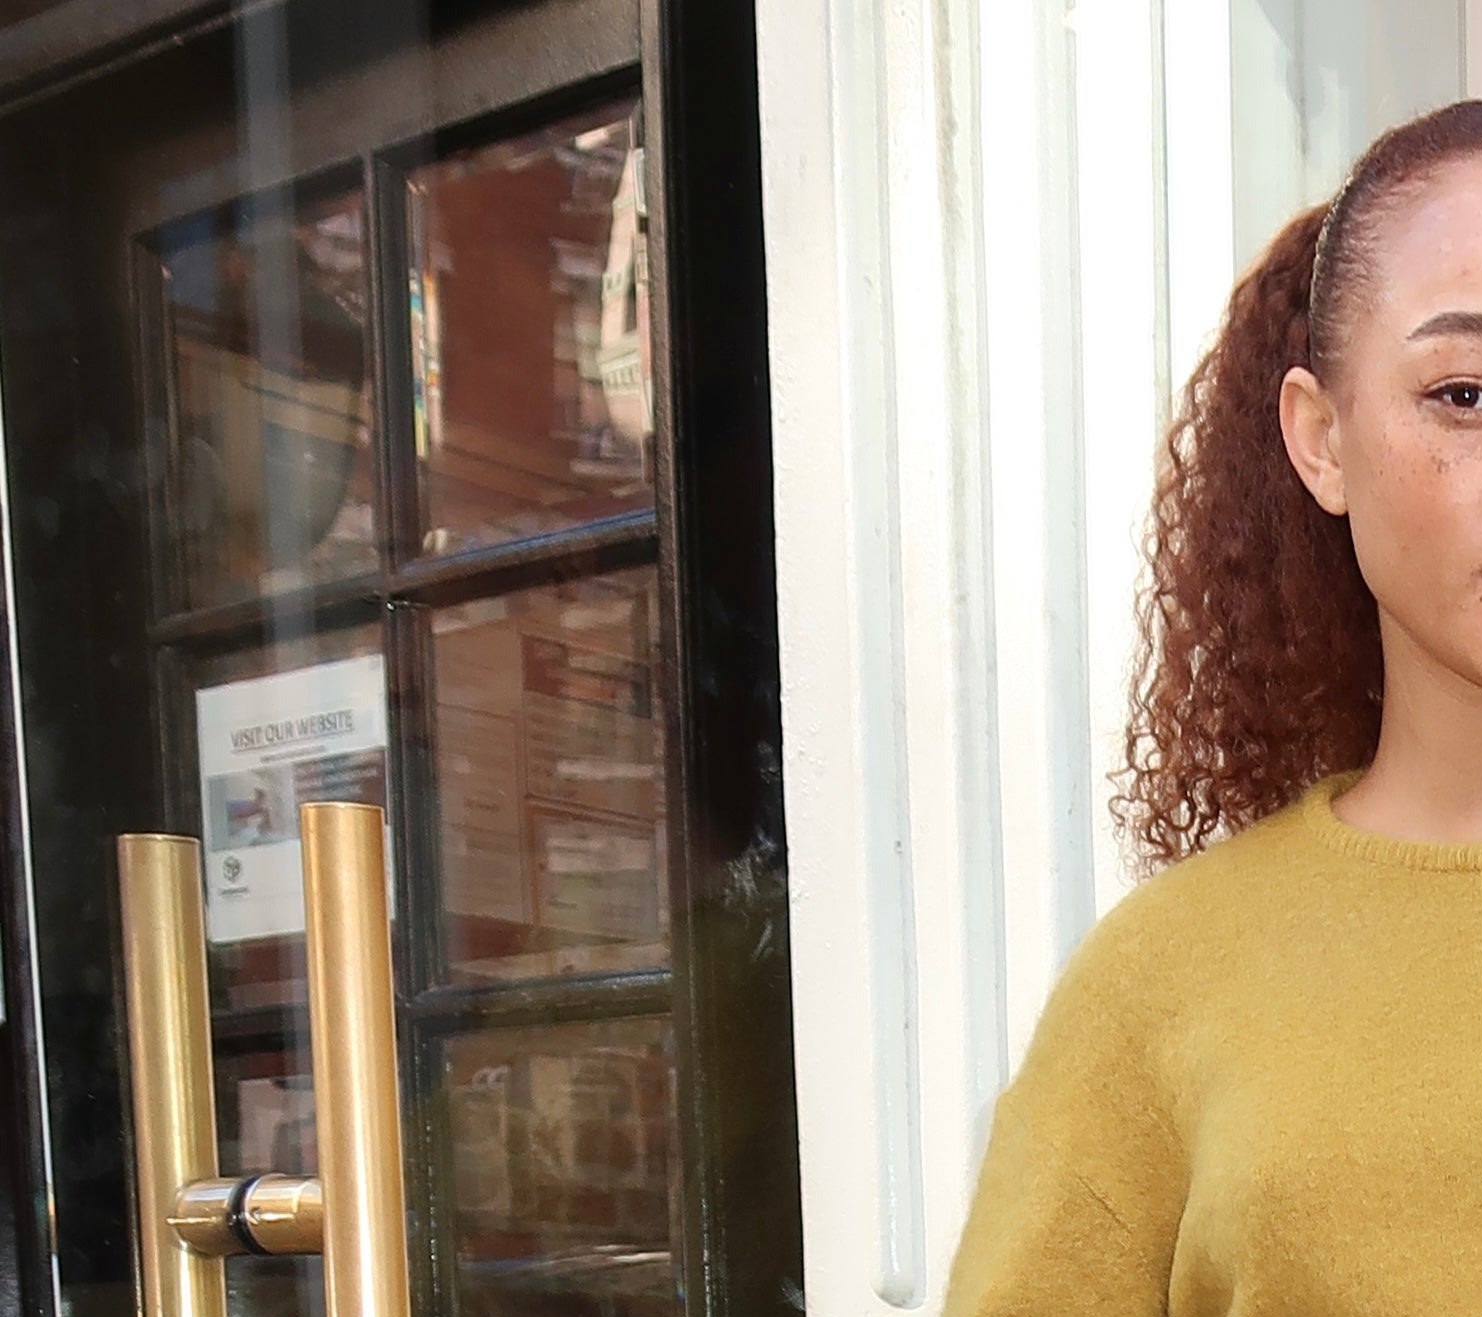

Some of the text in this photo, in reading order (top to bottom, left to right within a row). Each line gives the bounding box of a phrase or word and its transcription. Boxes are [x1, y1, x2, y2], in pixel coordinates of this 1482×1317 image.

[230, 709, 353, 748] VISIT OUR WEBSITE
